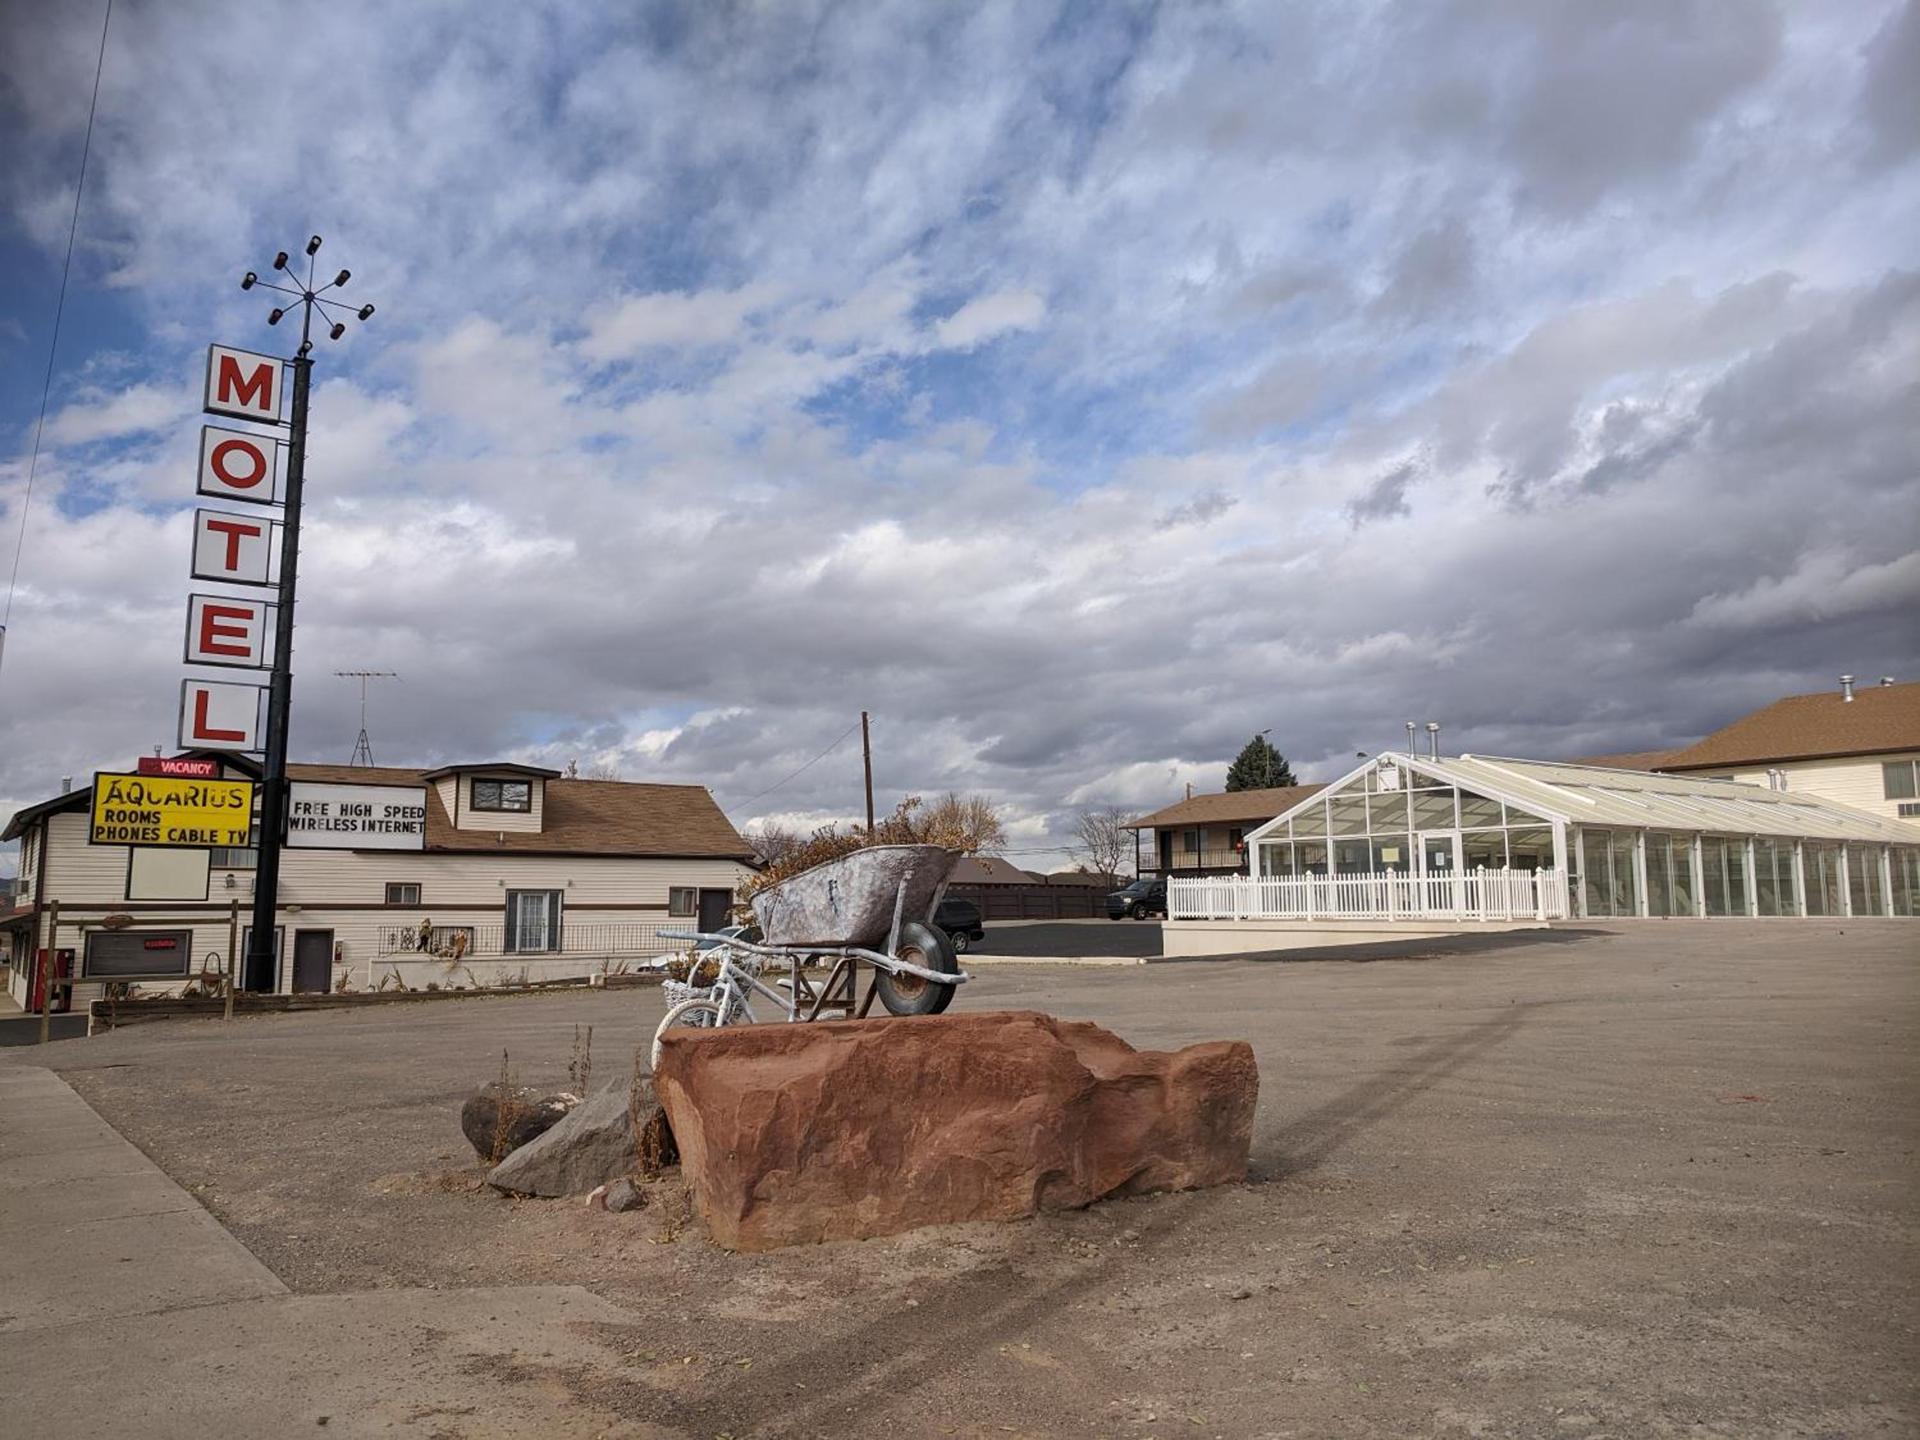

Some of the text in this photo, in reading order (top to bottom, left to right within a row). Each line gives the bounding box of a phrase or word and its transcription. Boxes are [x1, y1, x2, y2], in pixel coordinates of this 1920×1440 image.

[193, 354, 274, 742] MOTEL
[160, 761, 212, 775] VACANCY
[103, 779, 244, 809] AQUARIUS
[104, 809, 161, 824] ROOMS
[294, 802, 425, 819] FREE HIGH SPEED
[289, 817, 425, 834] WIRELESS INTERNET
[95, 826, 247, 844] PHONES CABLE TV
